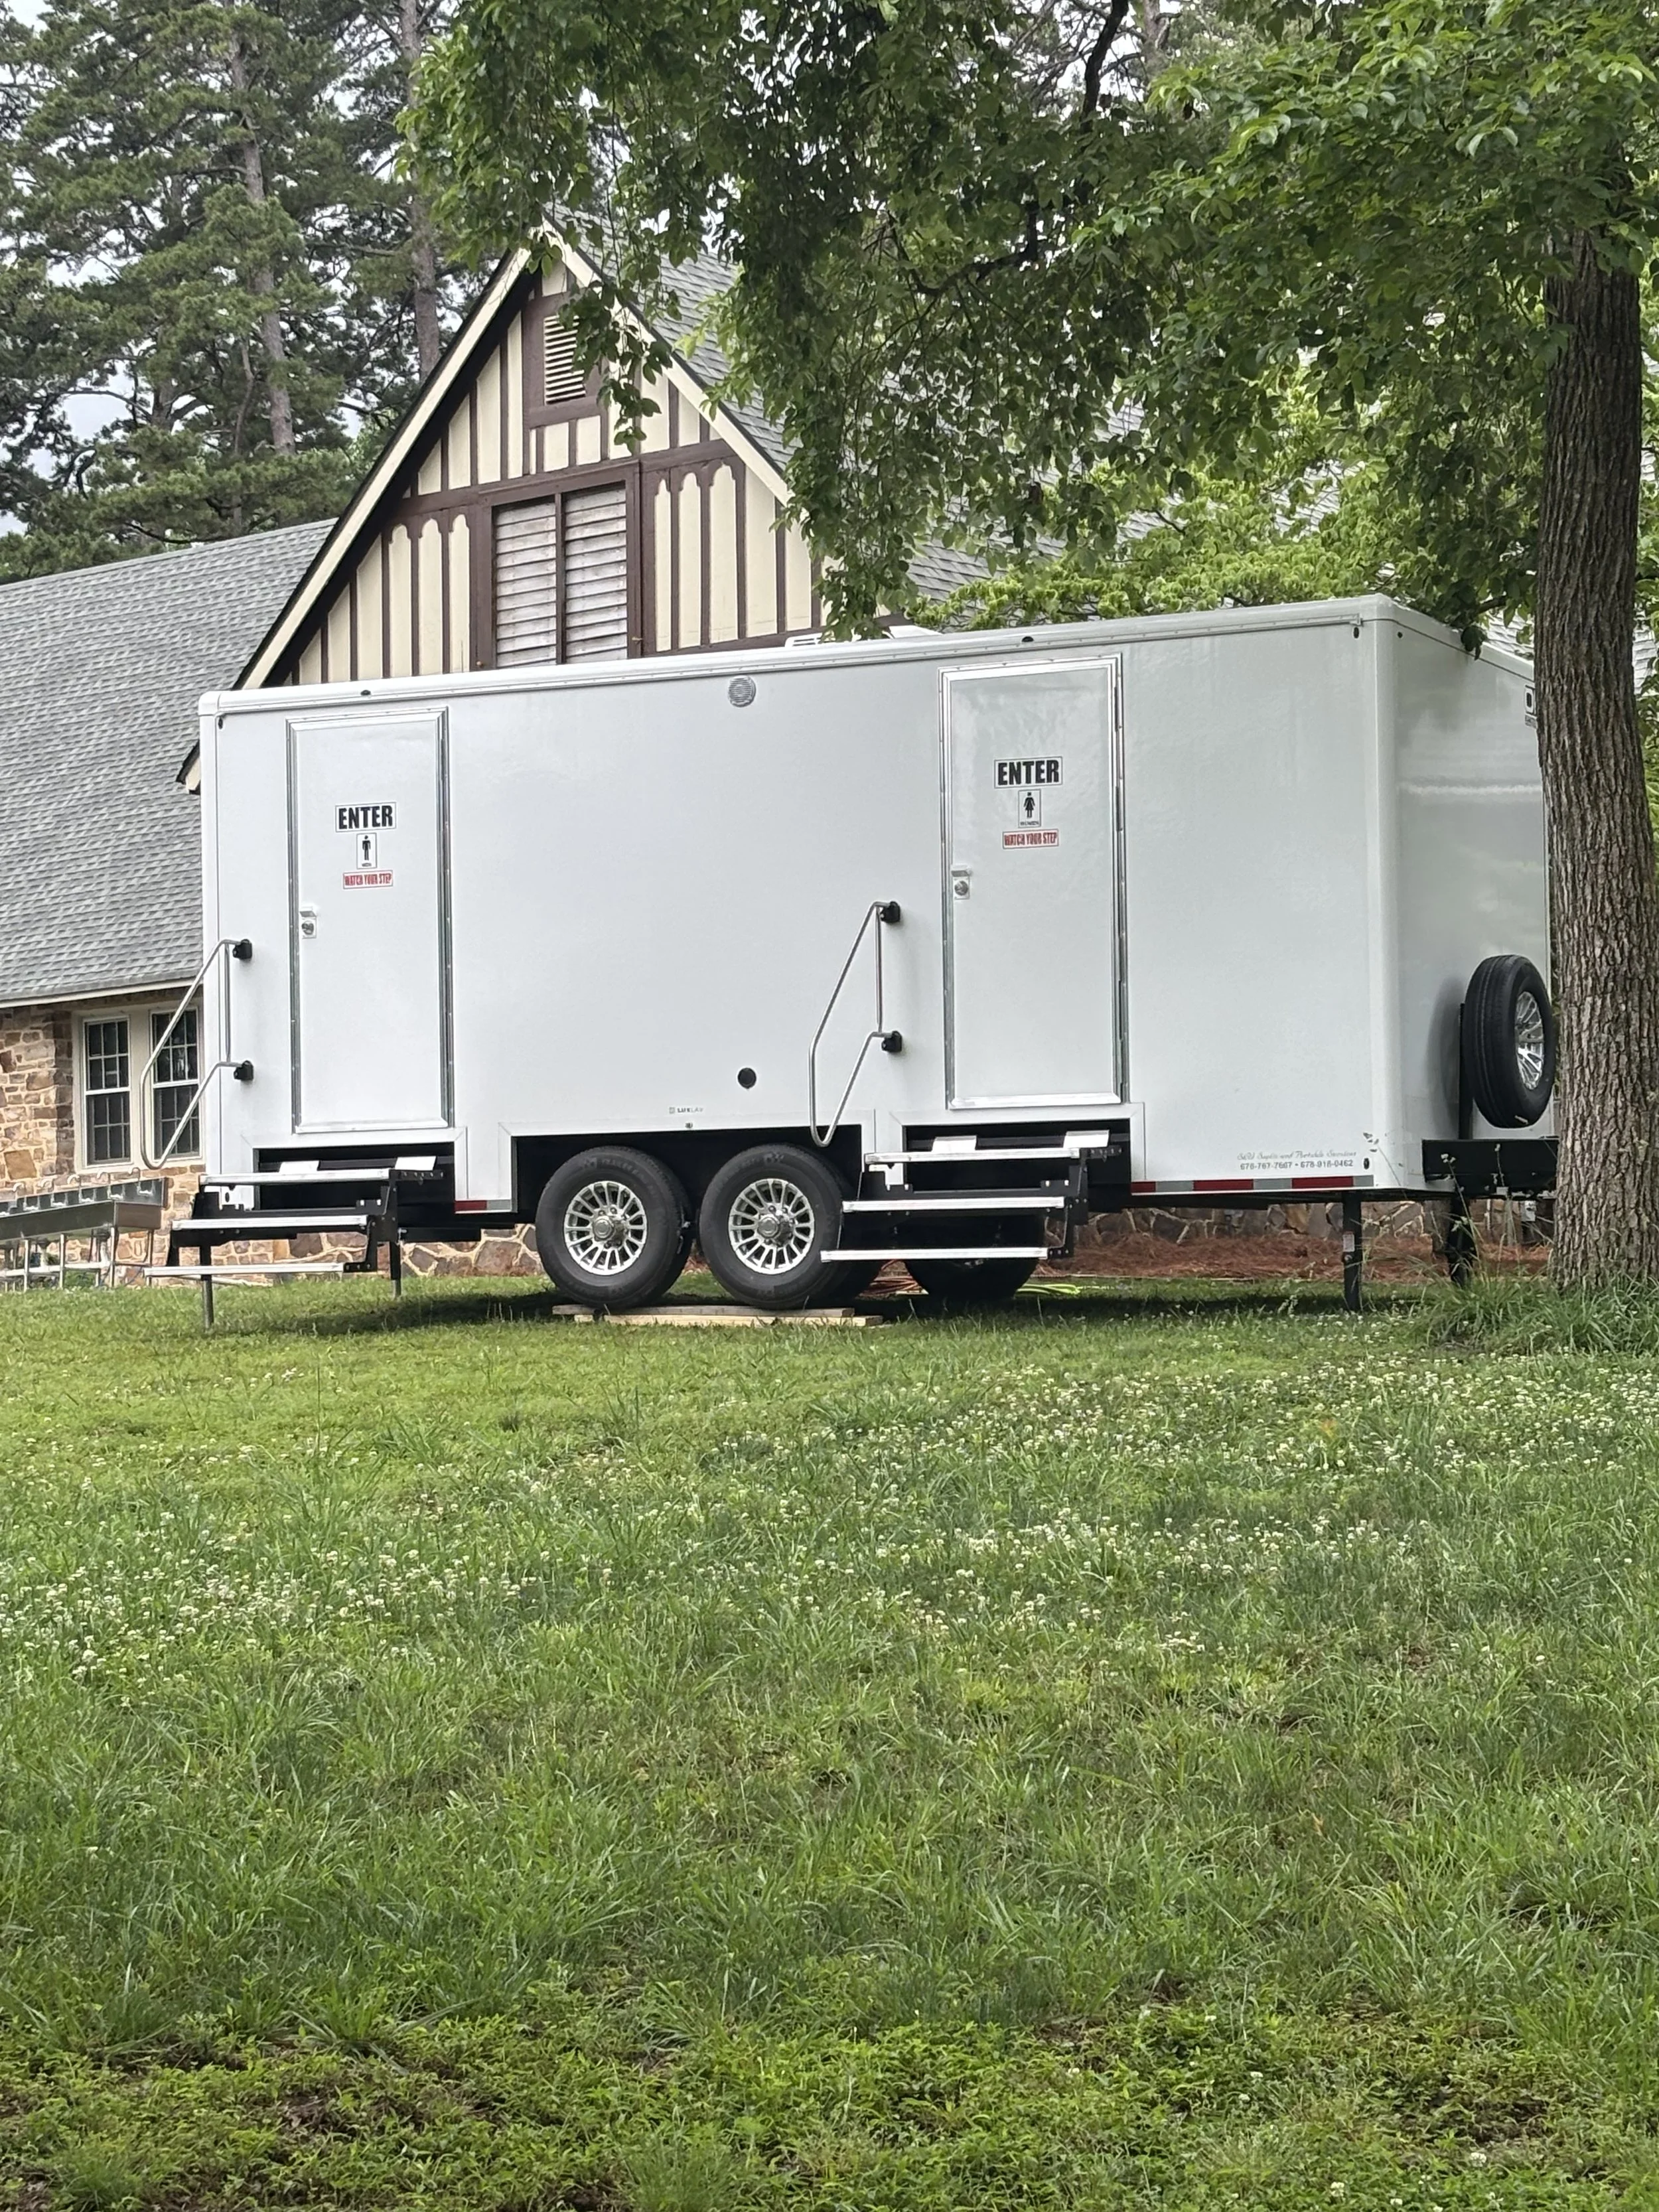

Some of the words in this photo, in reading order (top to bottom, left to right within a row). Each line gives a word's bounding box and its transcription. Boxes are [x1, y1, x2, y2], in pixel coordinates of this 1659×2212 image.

[997, 760, 1060, 785] ENTER
[338, 805, 393, 830] ENTER
[1004, 834, 1025, 846] WATCH
[1026, 832, 1043, 845] YOUR
[1043, 832, 1057, 844] STEP
[344, 875, 364, 886] WATCH
[378, 873, 392, 884] STEP
